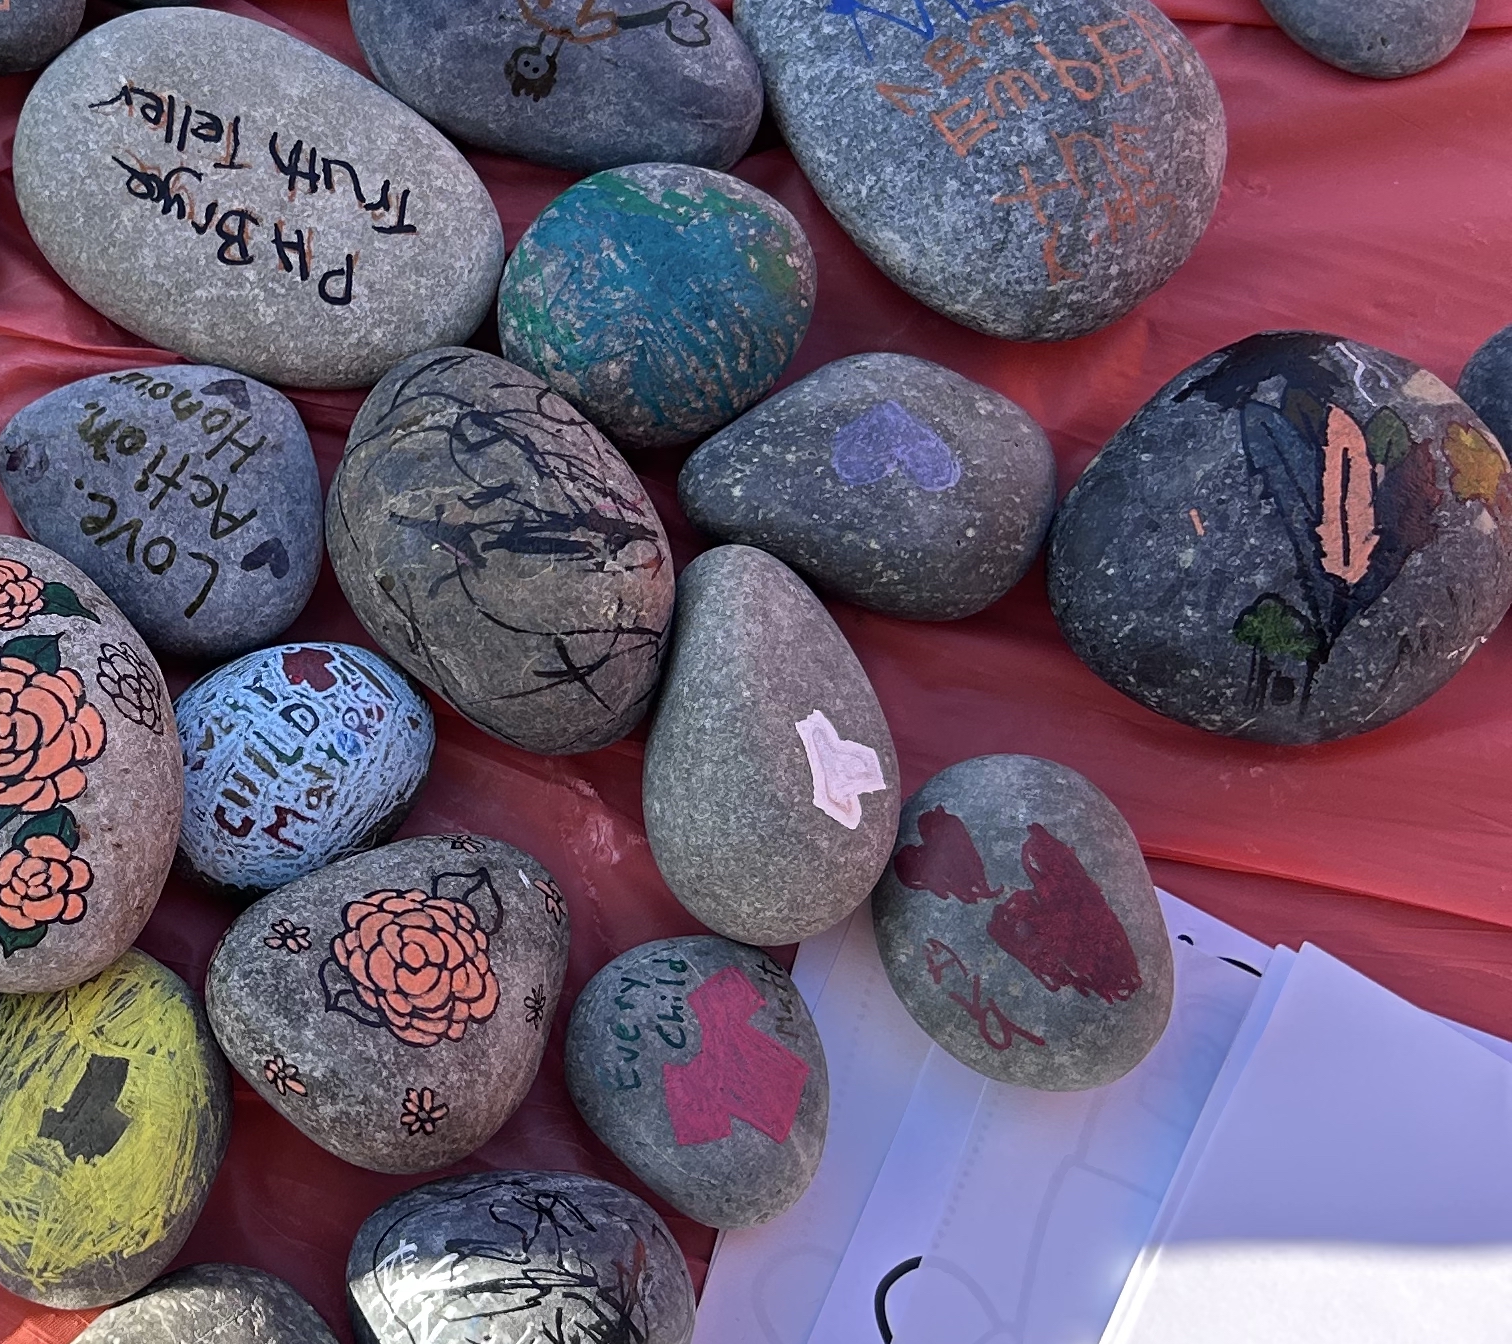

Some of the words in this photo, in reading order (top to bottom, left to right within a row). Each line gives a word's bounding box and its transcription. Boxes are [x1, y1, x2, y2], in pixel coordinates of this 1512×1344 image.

[88, 85, 242, 167] Teller
[268, 131, 415, 231] Truth
[213, 704, 320, 836] CHILD
[612, 976, 650, 1089] Every
[653, 957, 687, 1048] Child
